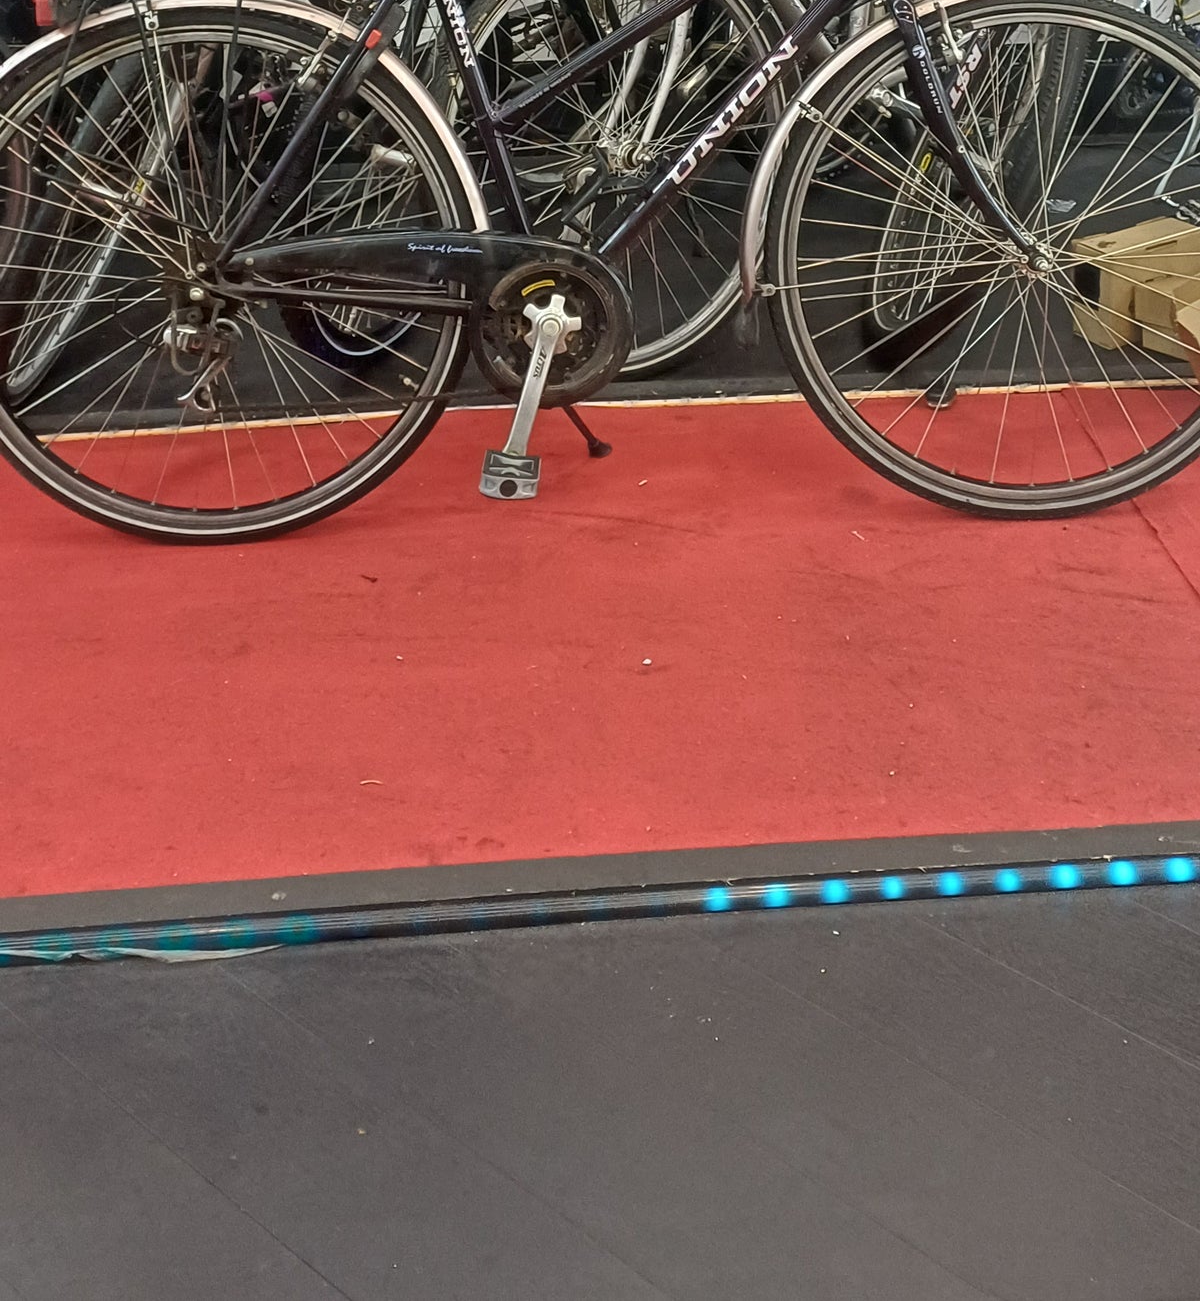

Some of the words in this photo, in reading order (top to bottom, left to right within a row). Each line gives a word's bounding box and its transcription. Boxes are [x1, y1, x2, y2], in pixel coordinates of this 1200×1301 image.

[920, 60, 944, 114] GOLDRUN
[949, 43, 982, 109] RST
[668, 35, 799, 186] UNION
